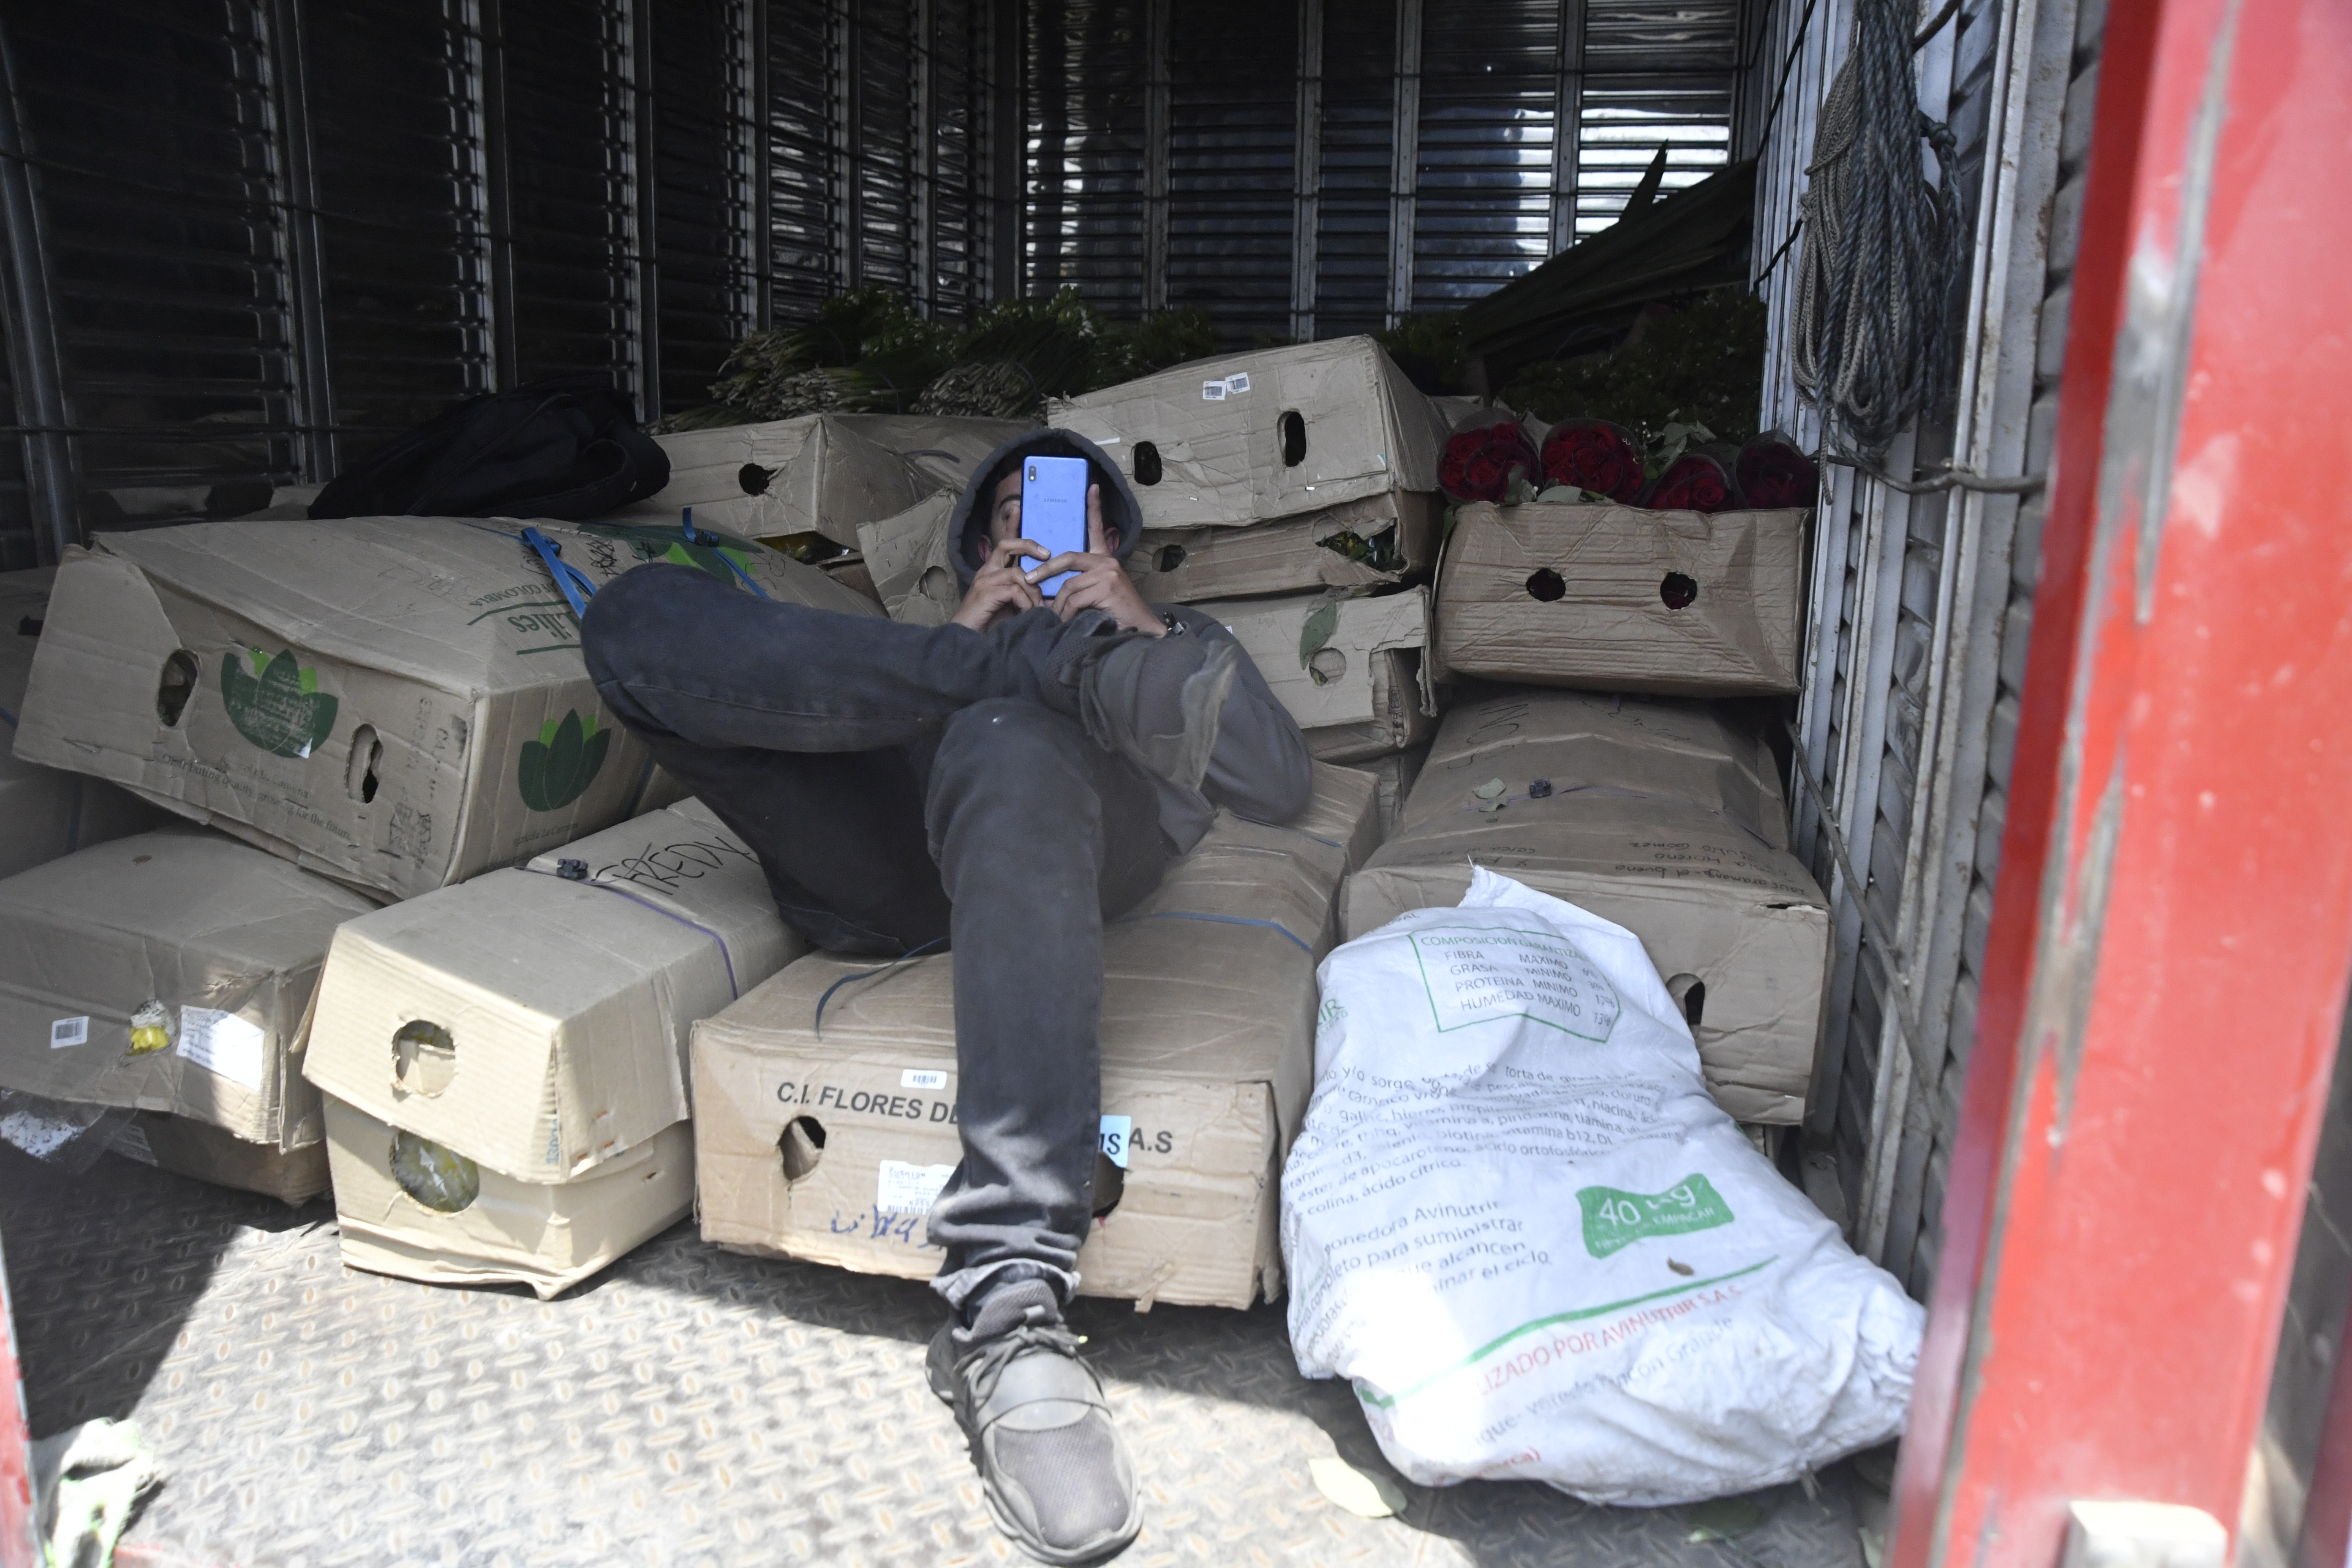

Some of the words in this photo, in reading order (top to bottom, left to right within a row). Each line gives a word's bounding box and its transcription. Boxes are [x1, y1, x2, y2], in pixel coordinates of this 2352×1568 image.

[469, 584, 541, 607] COLOMBIA
[297, 806, 309, 819] for
[310, 813, 325, 827] the
[1421, 936, 1517, 946] COMPOSICION
[1444, 950, 1485, 961] FIBRA
[1519, 953, 1568, 970] MAXIMO
[1450, 964, 1498, 976] GRASA
[1526, 967, 1572, 982] MINIMO
[1454, 976, 1525, 992] PROTEINA
[1532, 979, 1578, 997] MINIMO
[1460, 991, 1534, 1011] HUMEDAD
[1537, 993, 1581, 1017] MAXIMO
[1505, 1066, 1534, 1081] torta
[1537, 1071, 1553, 1082] de
[776, 1081, 810, 1105] C.I.
[818, 1085, 923, 1119] FLORES
[1307, 1193, 1358, 1215] colina,
[1362, 1174, 1407, 1198] ácido
[1414, 1199, 1500, 1223] Avinutrir
[1599, 1196, 1641, 1226] 40
[1367, 1241, 1409, 1267] para
[1414, 1217, 1523, 1249] suministrar
[1439, 1240, 1526, 1269] alcancen
[1481, 1263, 1500, 1280] el
[1553, 1331, 1599, 1359] POR
[1602, 1298, 1699, 1348] AVINUTRIR
